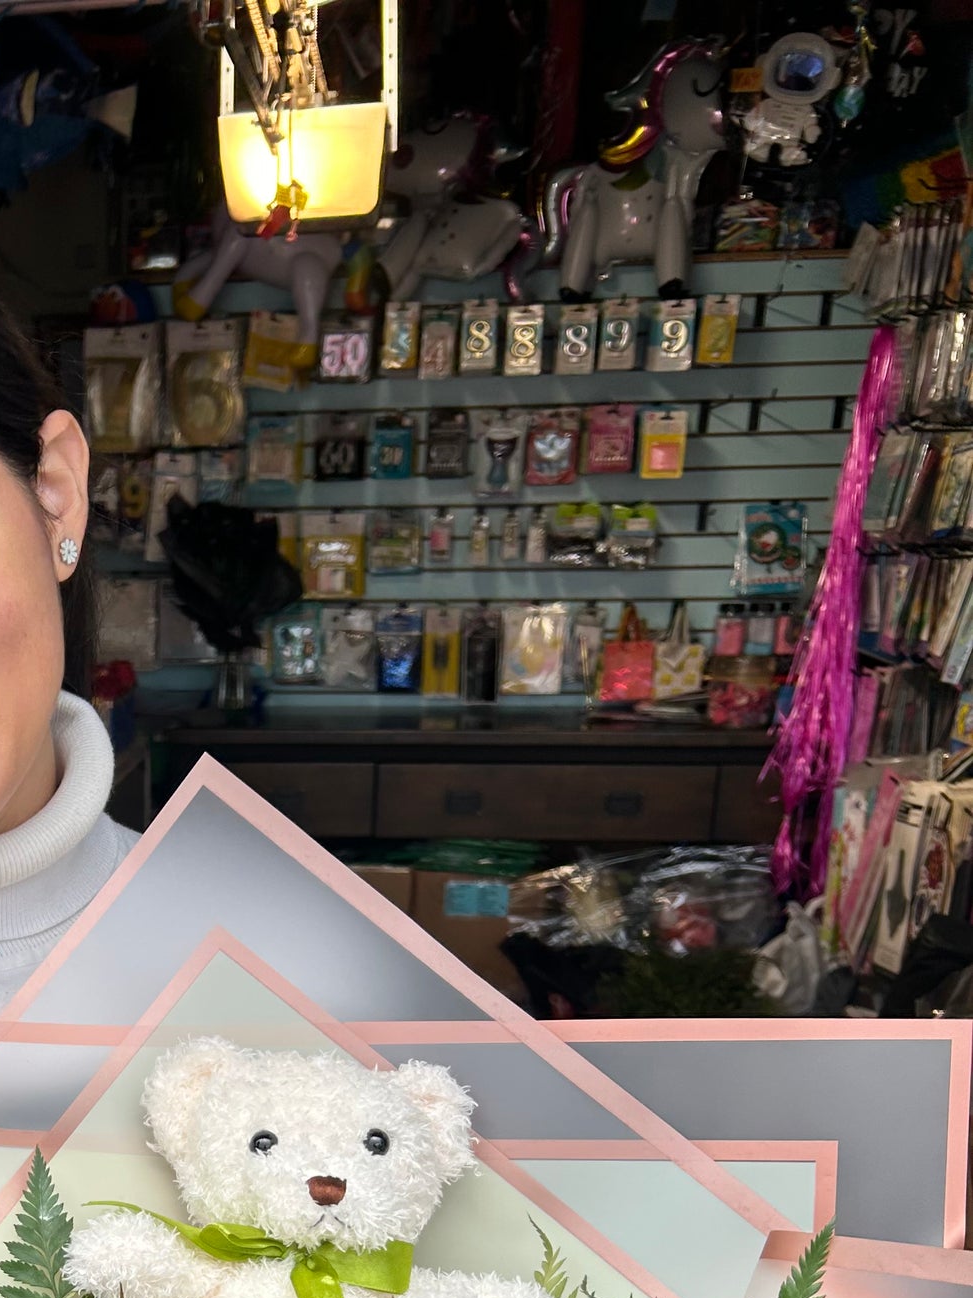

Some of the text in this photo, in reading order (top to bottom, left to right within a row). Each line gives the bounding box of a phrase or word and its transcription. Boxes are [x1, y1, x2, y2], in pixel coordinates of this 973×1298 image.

[467, 320, 492, 353] 8
[511, 325, 536, 358] 8
[563, 325, 588, 357] 8
[604, 319, 631, 352] 9
[661, 319, 688, 353] 9
[321, 334, 367, 372] 50
[122, 475, 149, 518] 9
